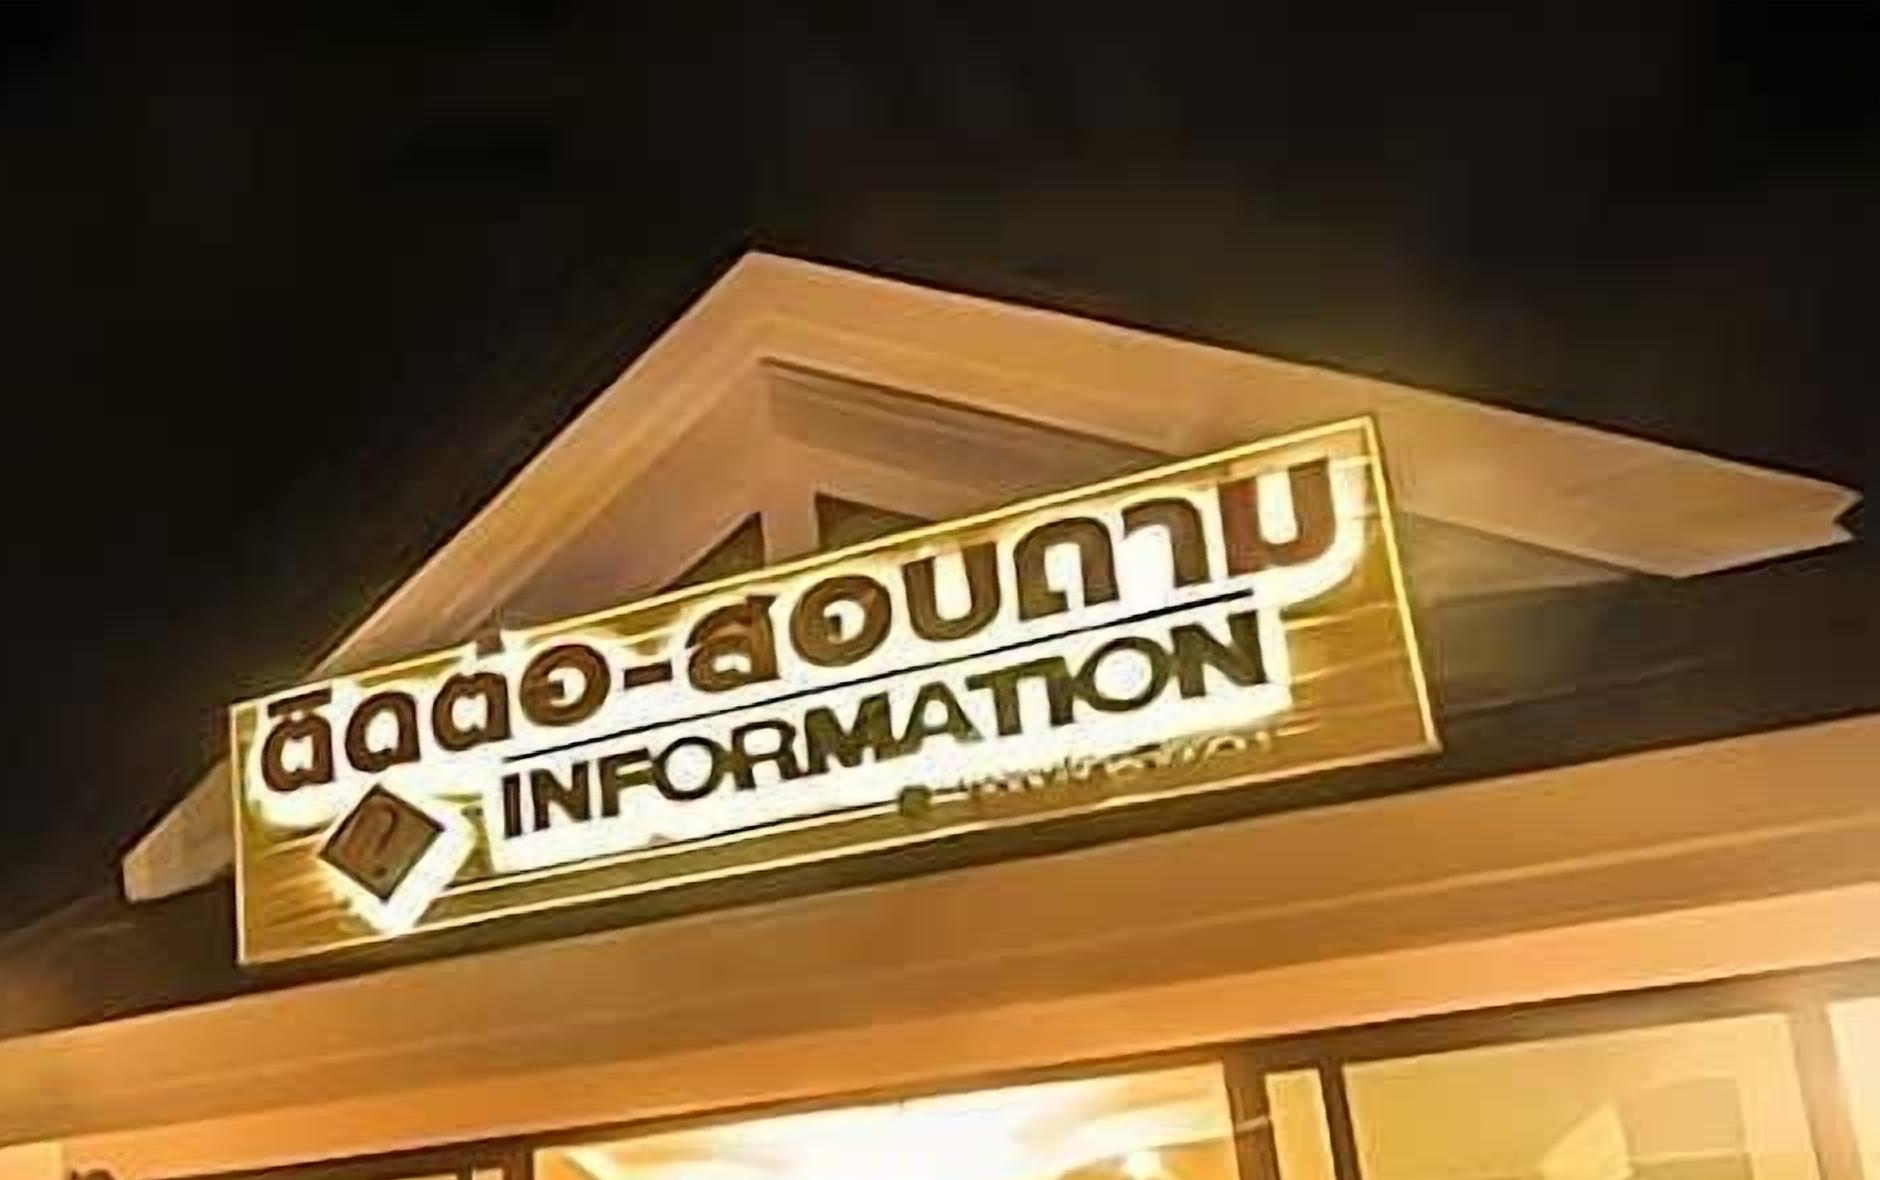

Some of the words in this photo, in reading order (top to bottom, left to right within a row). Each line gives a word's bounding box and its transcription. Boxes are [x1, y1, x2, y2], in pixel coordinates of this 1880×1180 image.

[260, 456, 1339, 793] ติดต่อ-สอบถาม
[500, 608, 1269, 839] INFORMATION
